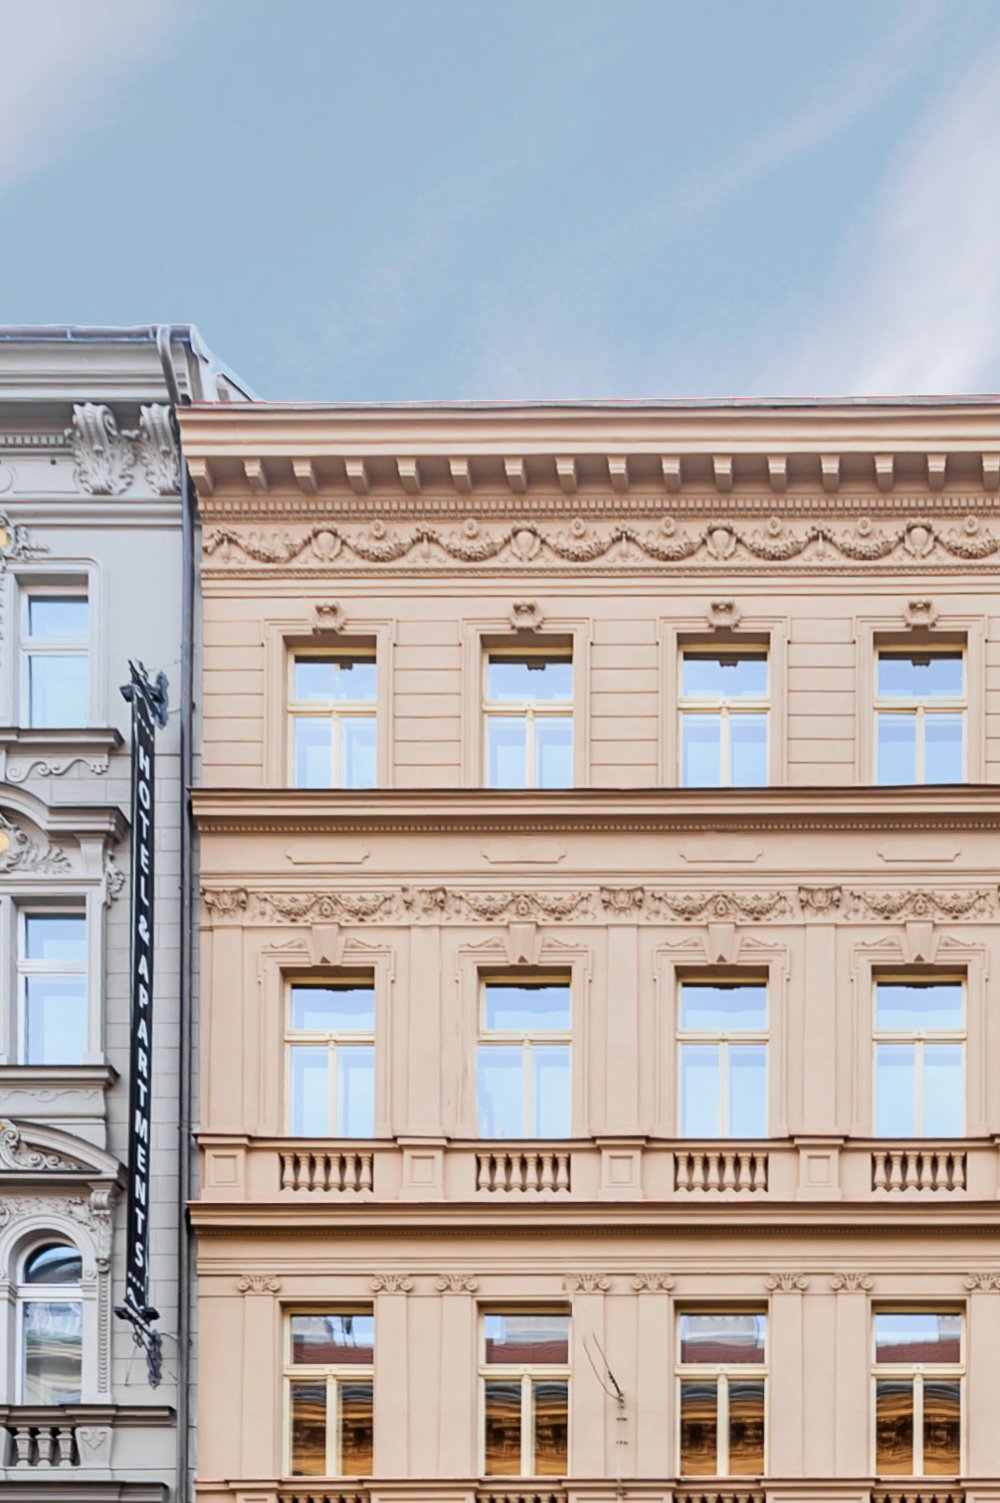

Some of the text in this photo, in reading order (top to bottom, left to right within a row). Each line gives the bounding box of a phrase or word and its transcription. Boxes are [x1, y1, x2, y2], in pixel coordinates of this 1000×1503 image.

[134, 745, 151, 1268] HOTEL & APARTMENTS
